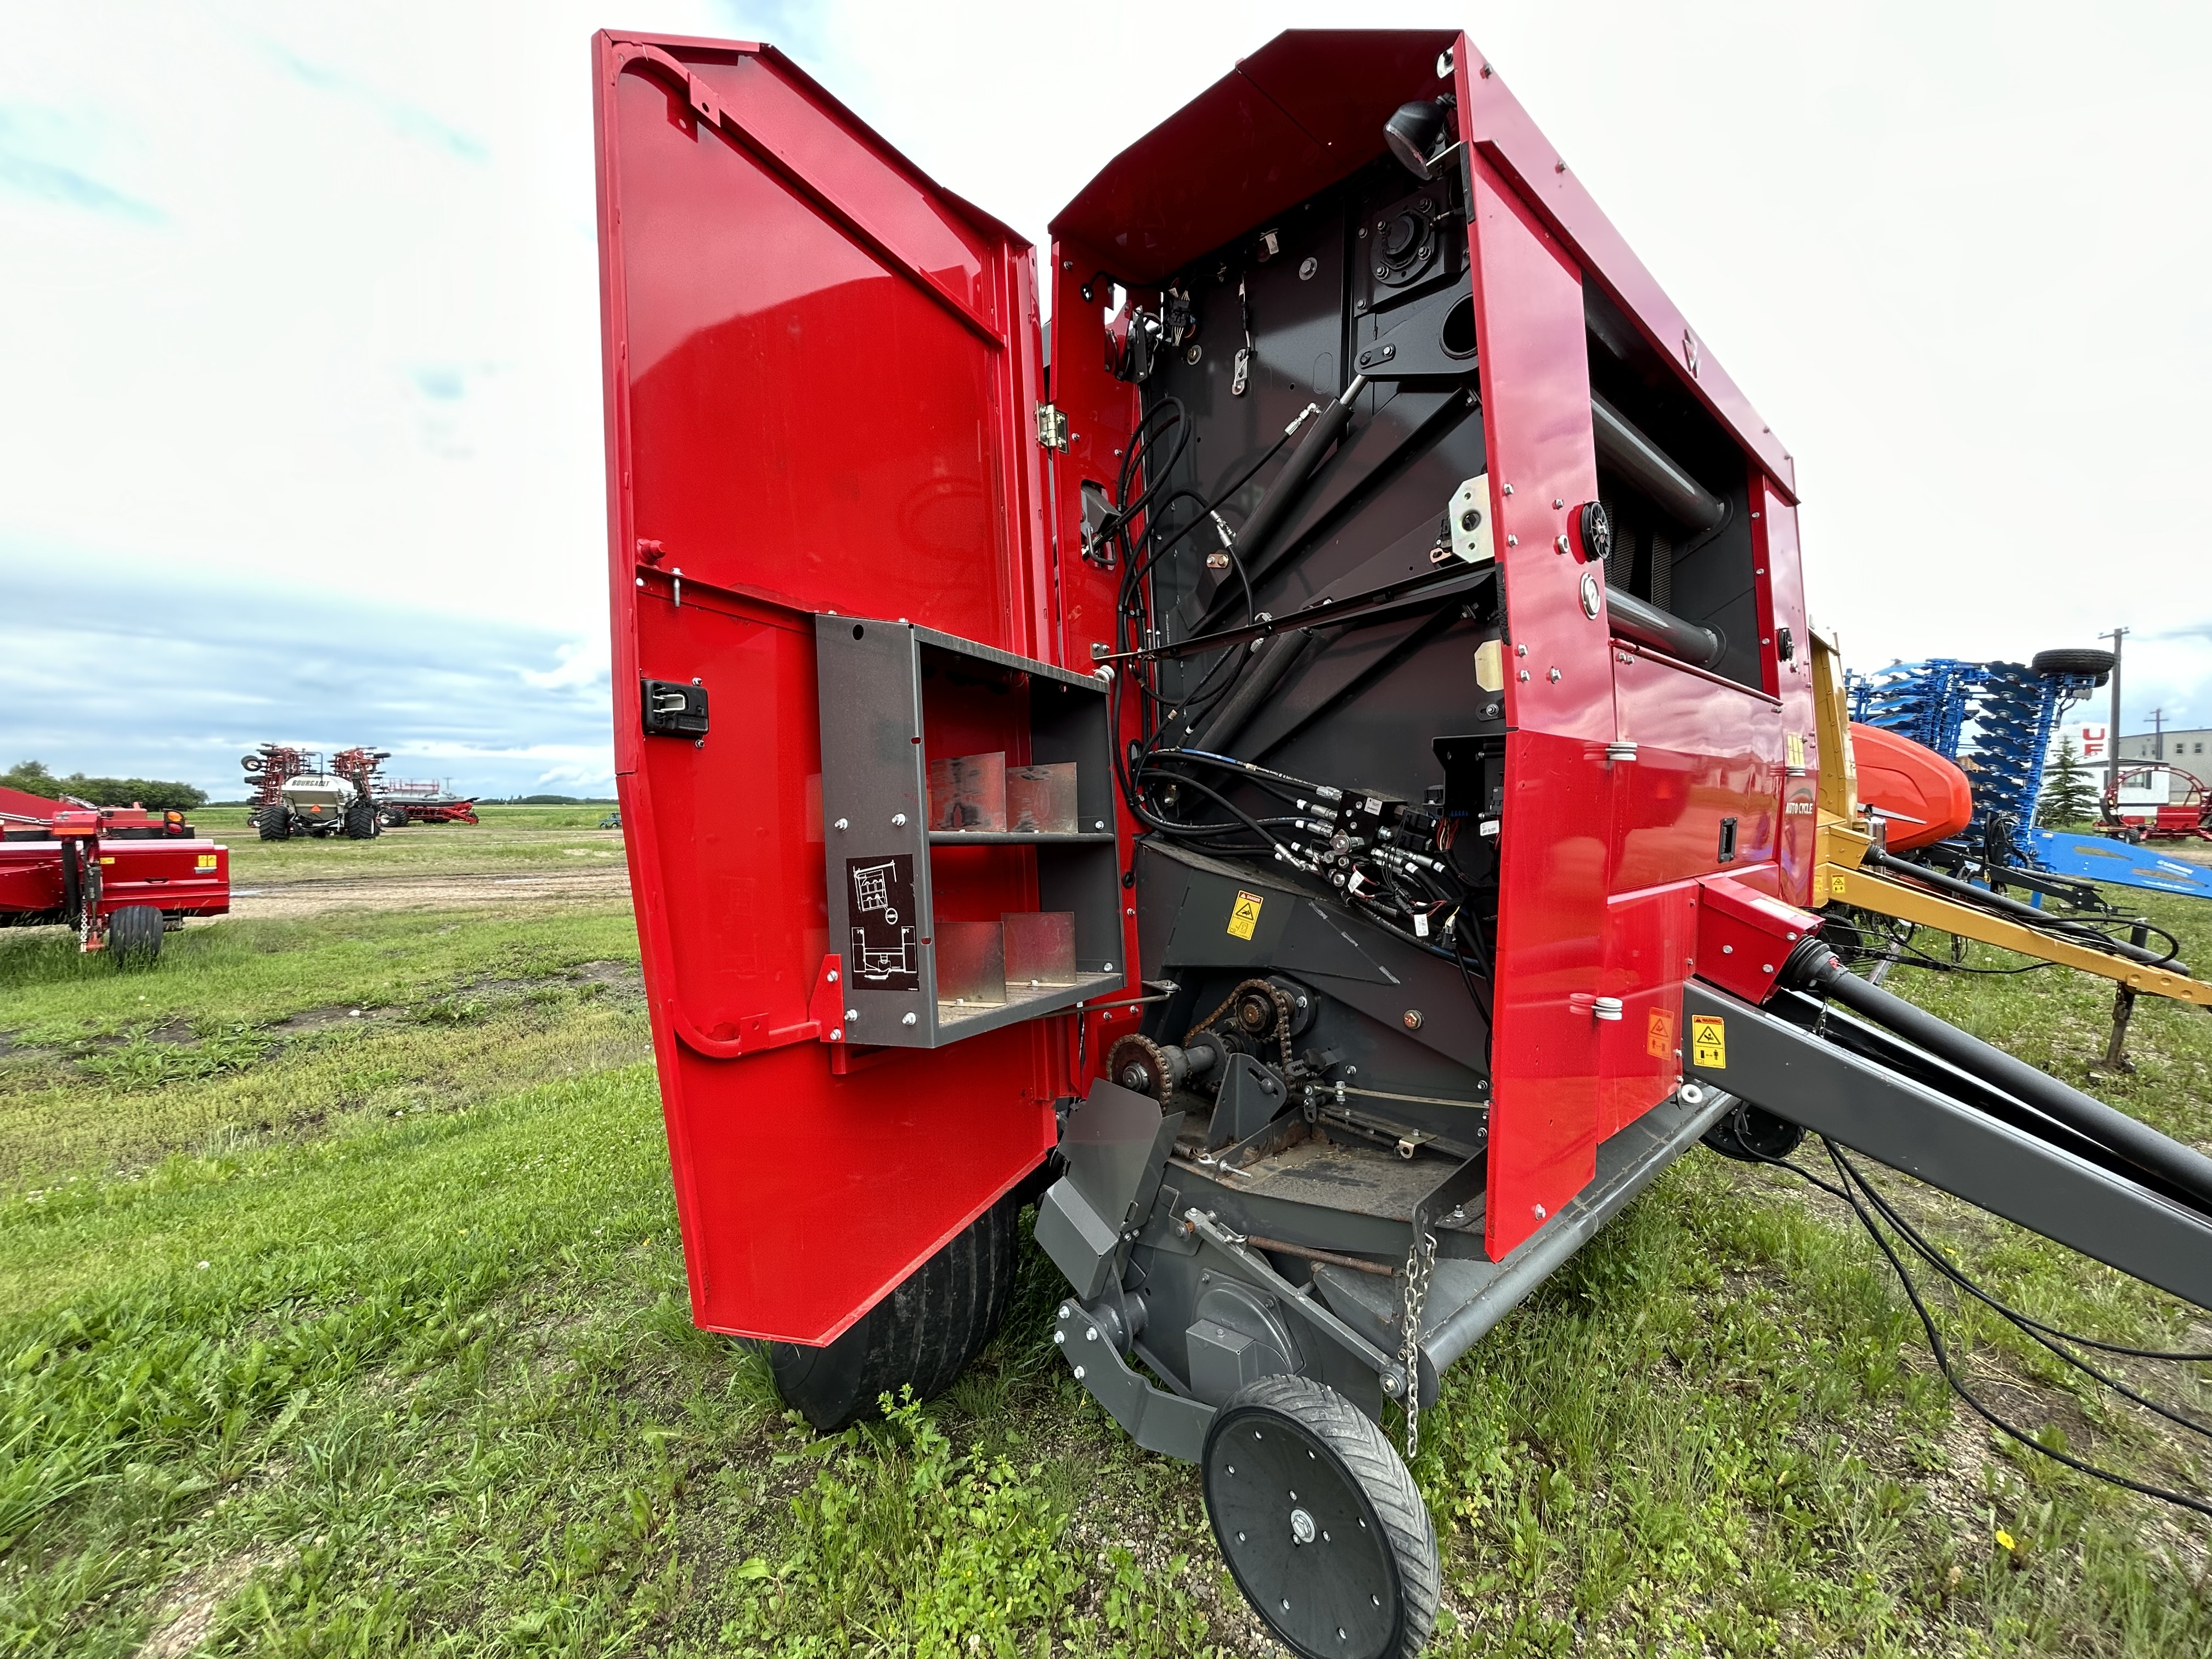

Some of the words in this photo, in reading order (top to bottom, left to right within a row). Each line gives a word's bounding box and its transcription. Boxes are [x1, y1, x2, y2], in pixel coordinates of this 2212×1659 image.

[1785, 803, 1798, 814] AUTO
[1798, 803, 1813, 814] CYCLE
[1246, 894, 1261, 903] DANGER
